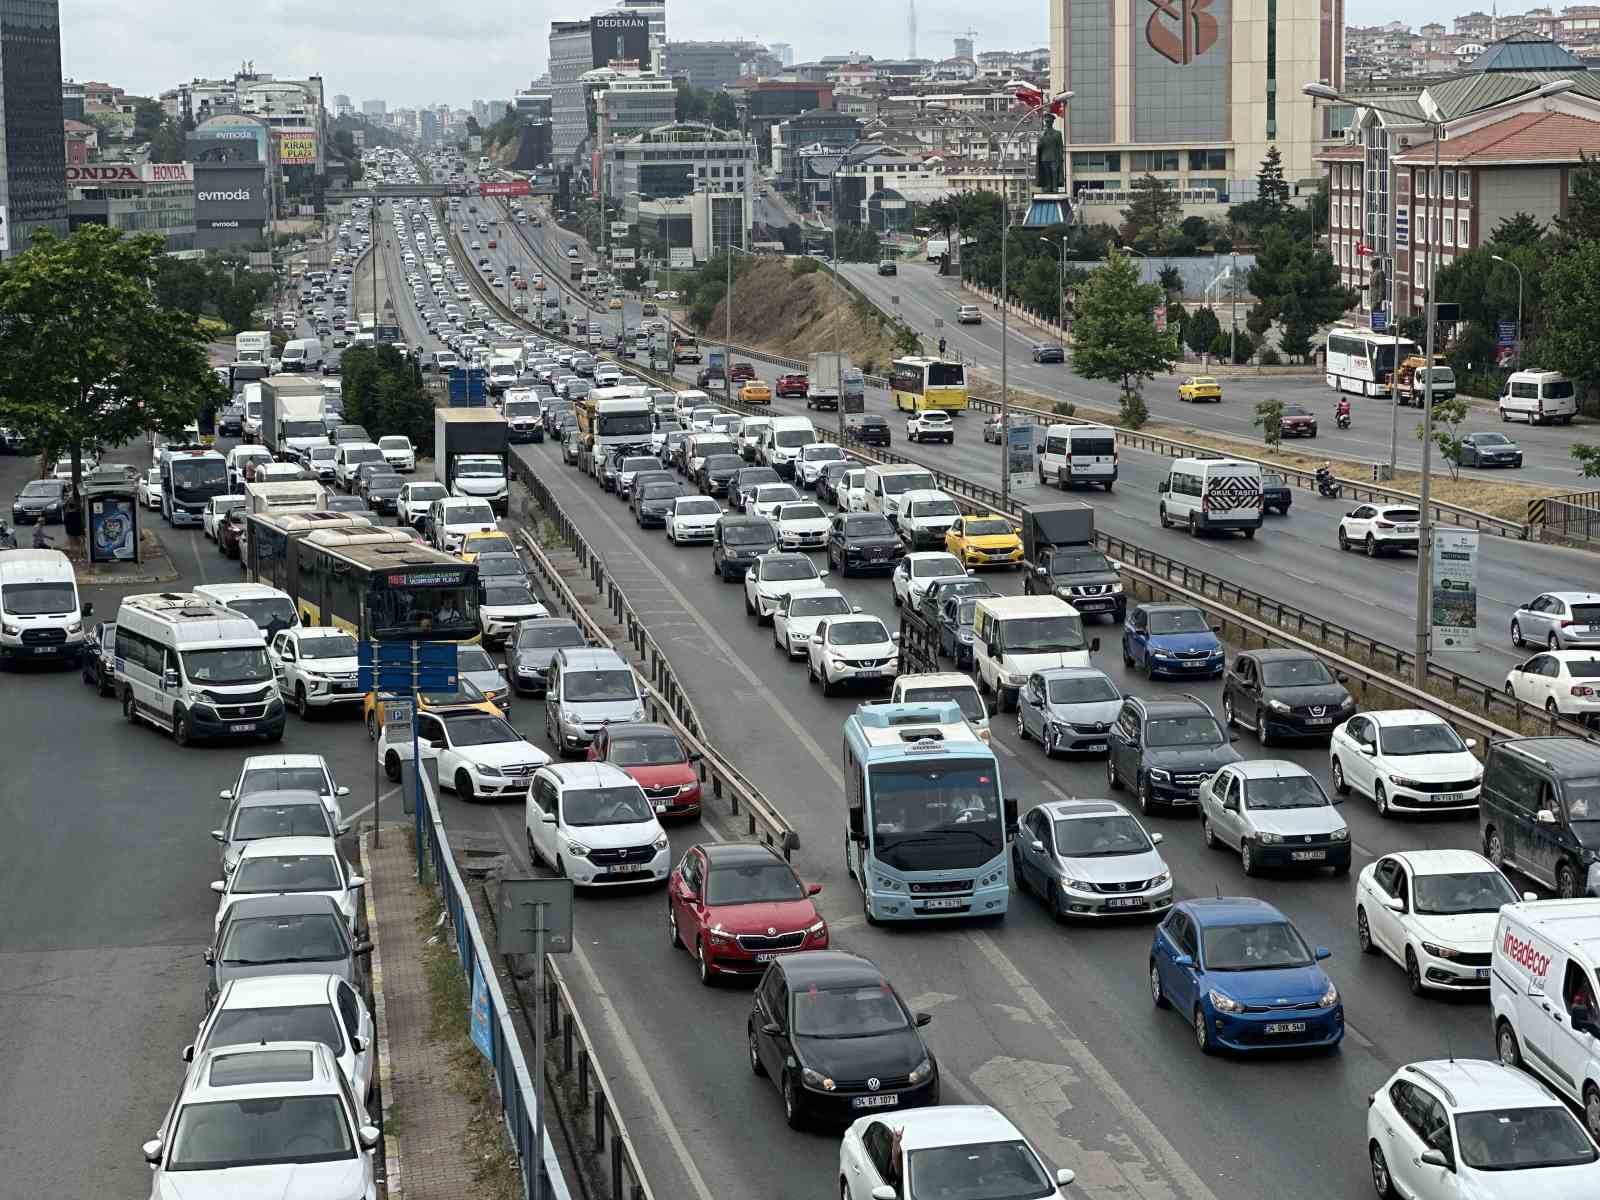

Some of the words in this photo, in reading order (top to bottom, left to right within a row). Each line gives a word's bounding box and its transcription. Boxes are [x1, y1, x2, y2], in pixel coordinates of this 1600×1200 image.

[597, 19, 644, 27] DEDEMAN
[65, 167, 138, 180] ONDA
[153, 166, 186, 180] HONDA
[198, 188, 250, 200] evmoda
[1503, 926, 1551, 976] lineadecor
[880, 1094, 896, 1104] 1071
